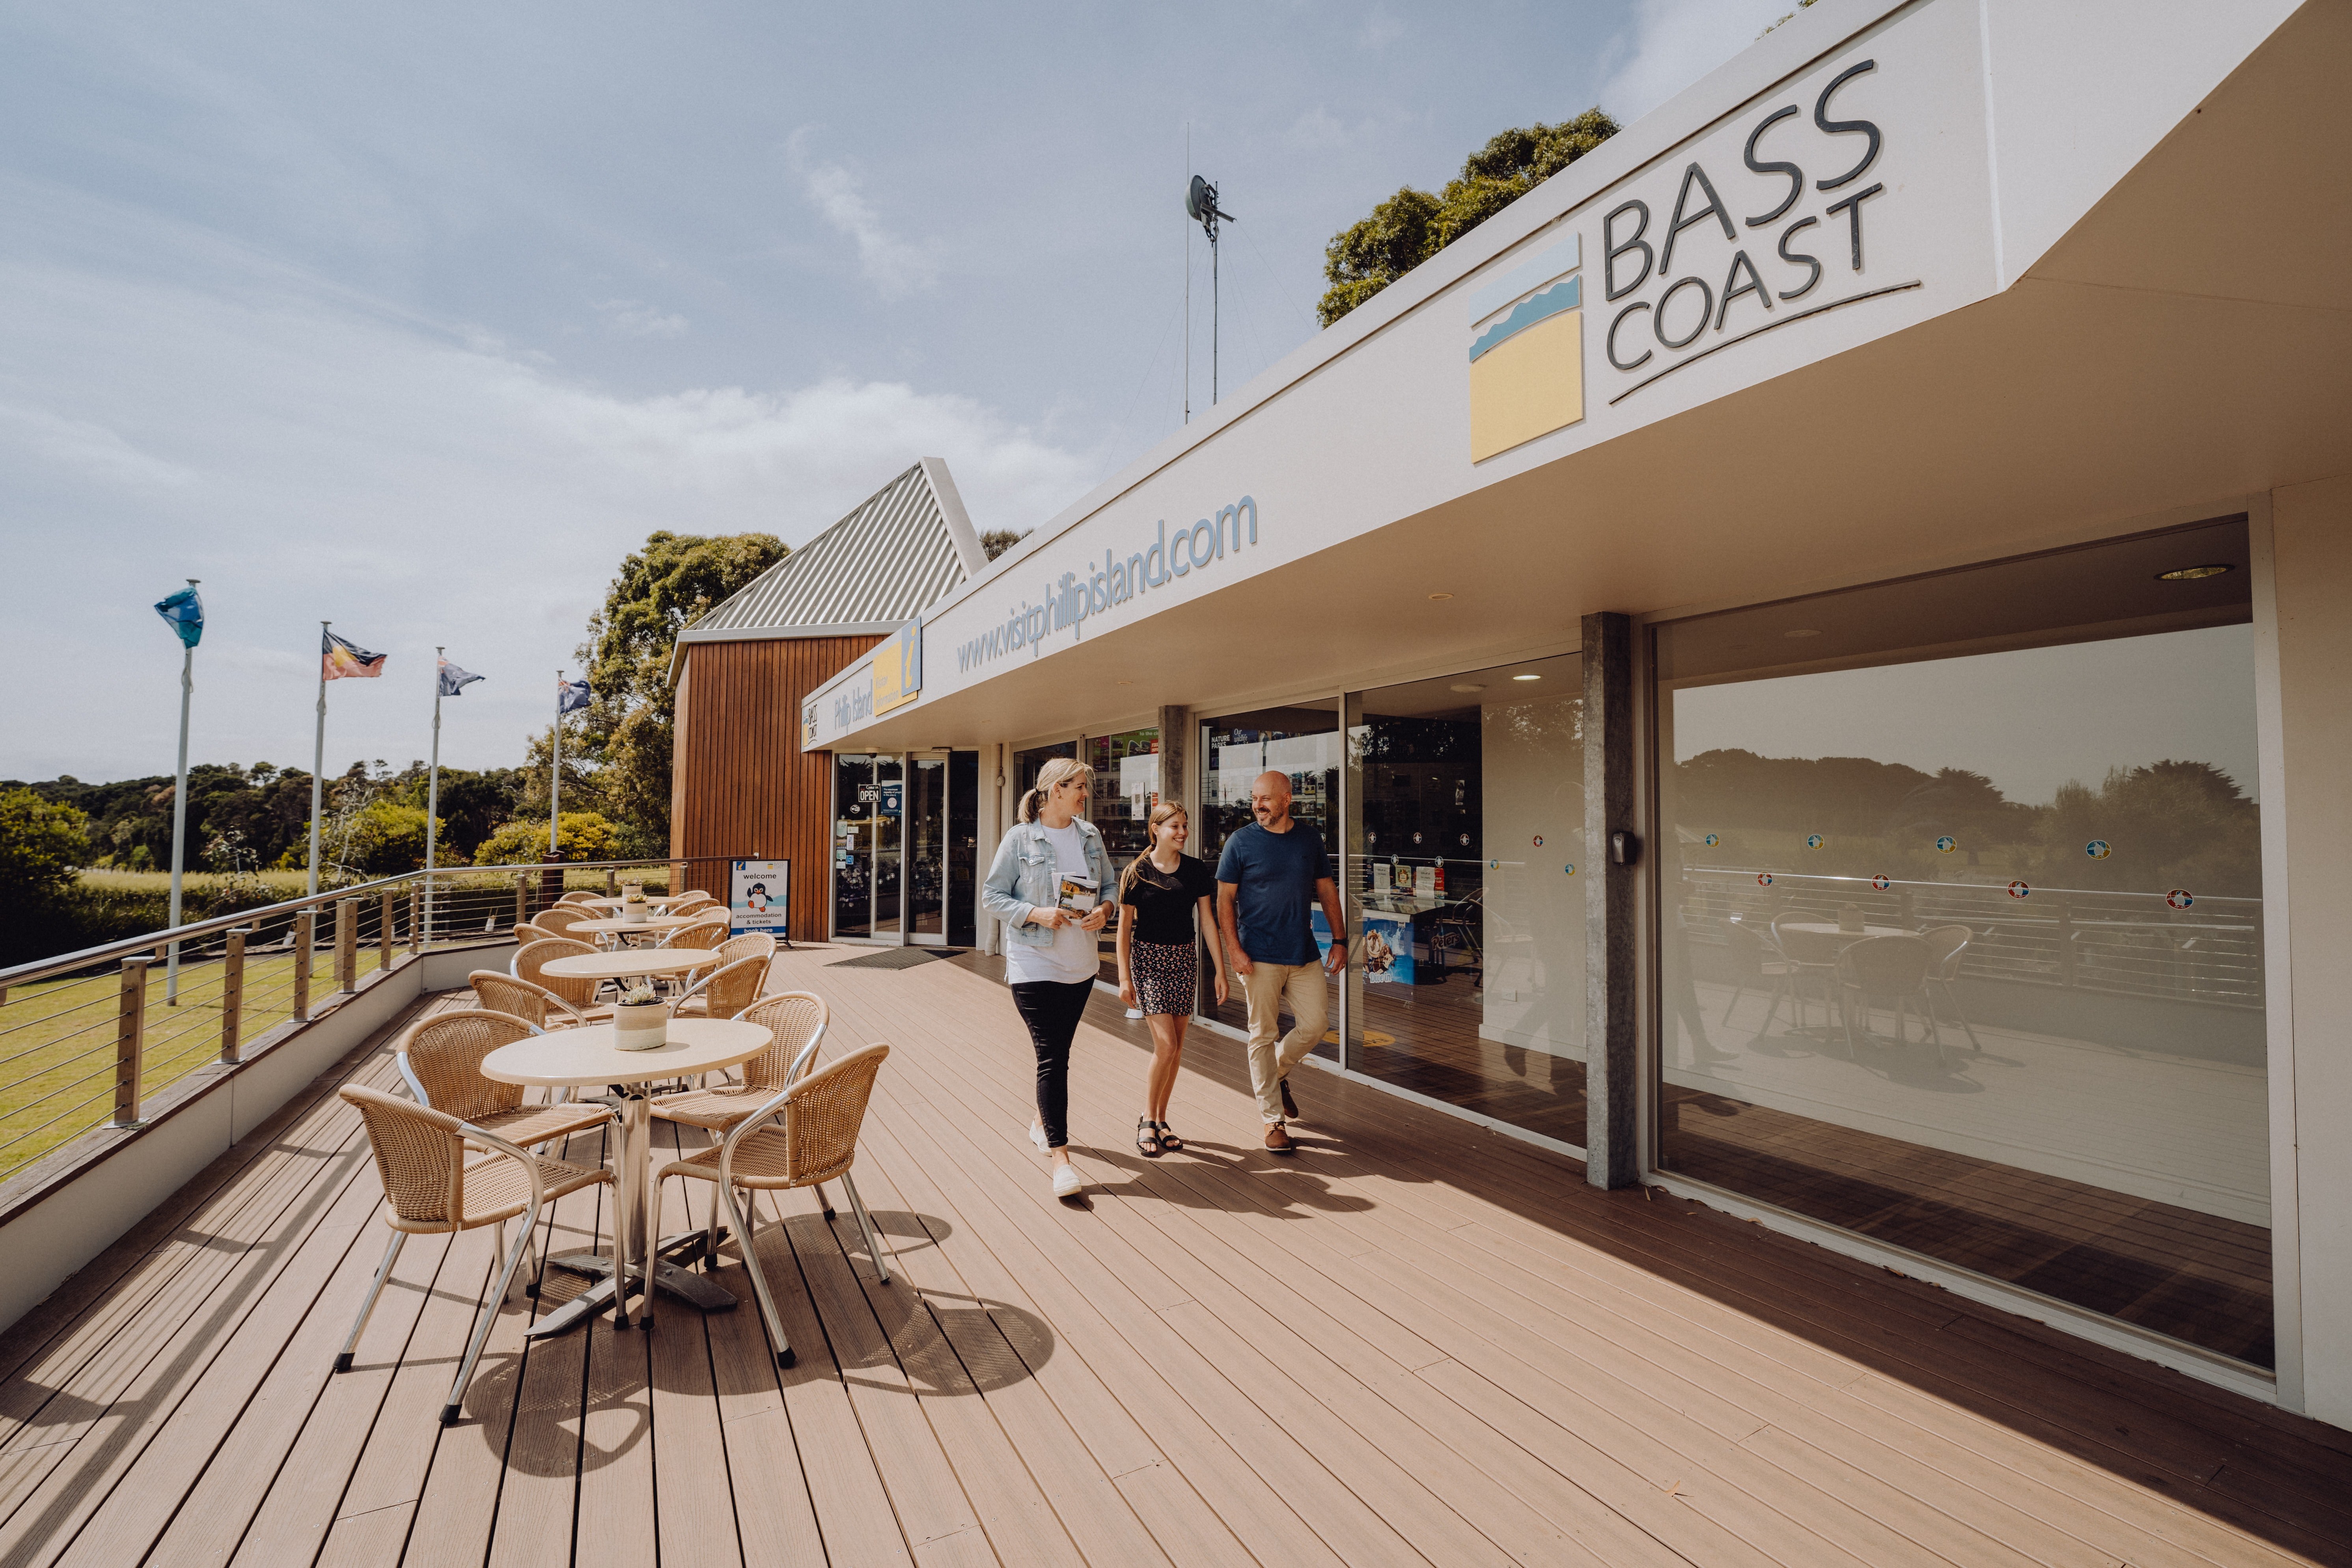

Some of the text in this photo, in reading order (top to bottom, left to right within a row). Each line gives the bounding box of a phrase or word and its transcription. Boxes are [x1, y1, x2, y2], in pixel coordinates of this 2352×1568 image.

[1603, 58, 1880, 301] BASS
[1606, 182, 1883, 370] COAST
[957, 495, 1257, 673] www.visitphillipisland.com
[875, 675, 888, 690] Visitor
[834, 679, 873, 736] Phillip Island
[876, 690, 899, 708] Information
[809, 704, 817, 725] BASS
[809, 724, 817, 739] COAST
[1234, 734, 1248, 743] wildlife
[860, 791, 879, 801] OPEN
[1431, 933, 1460, 950] Peters
[1369, 972, 1391, 983] Dive in
